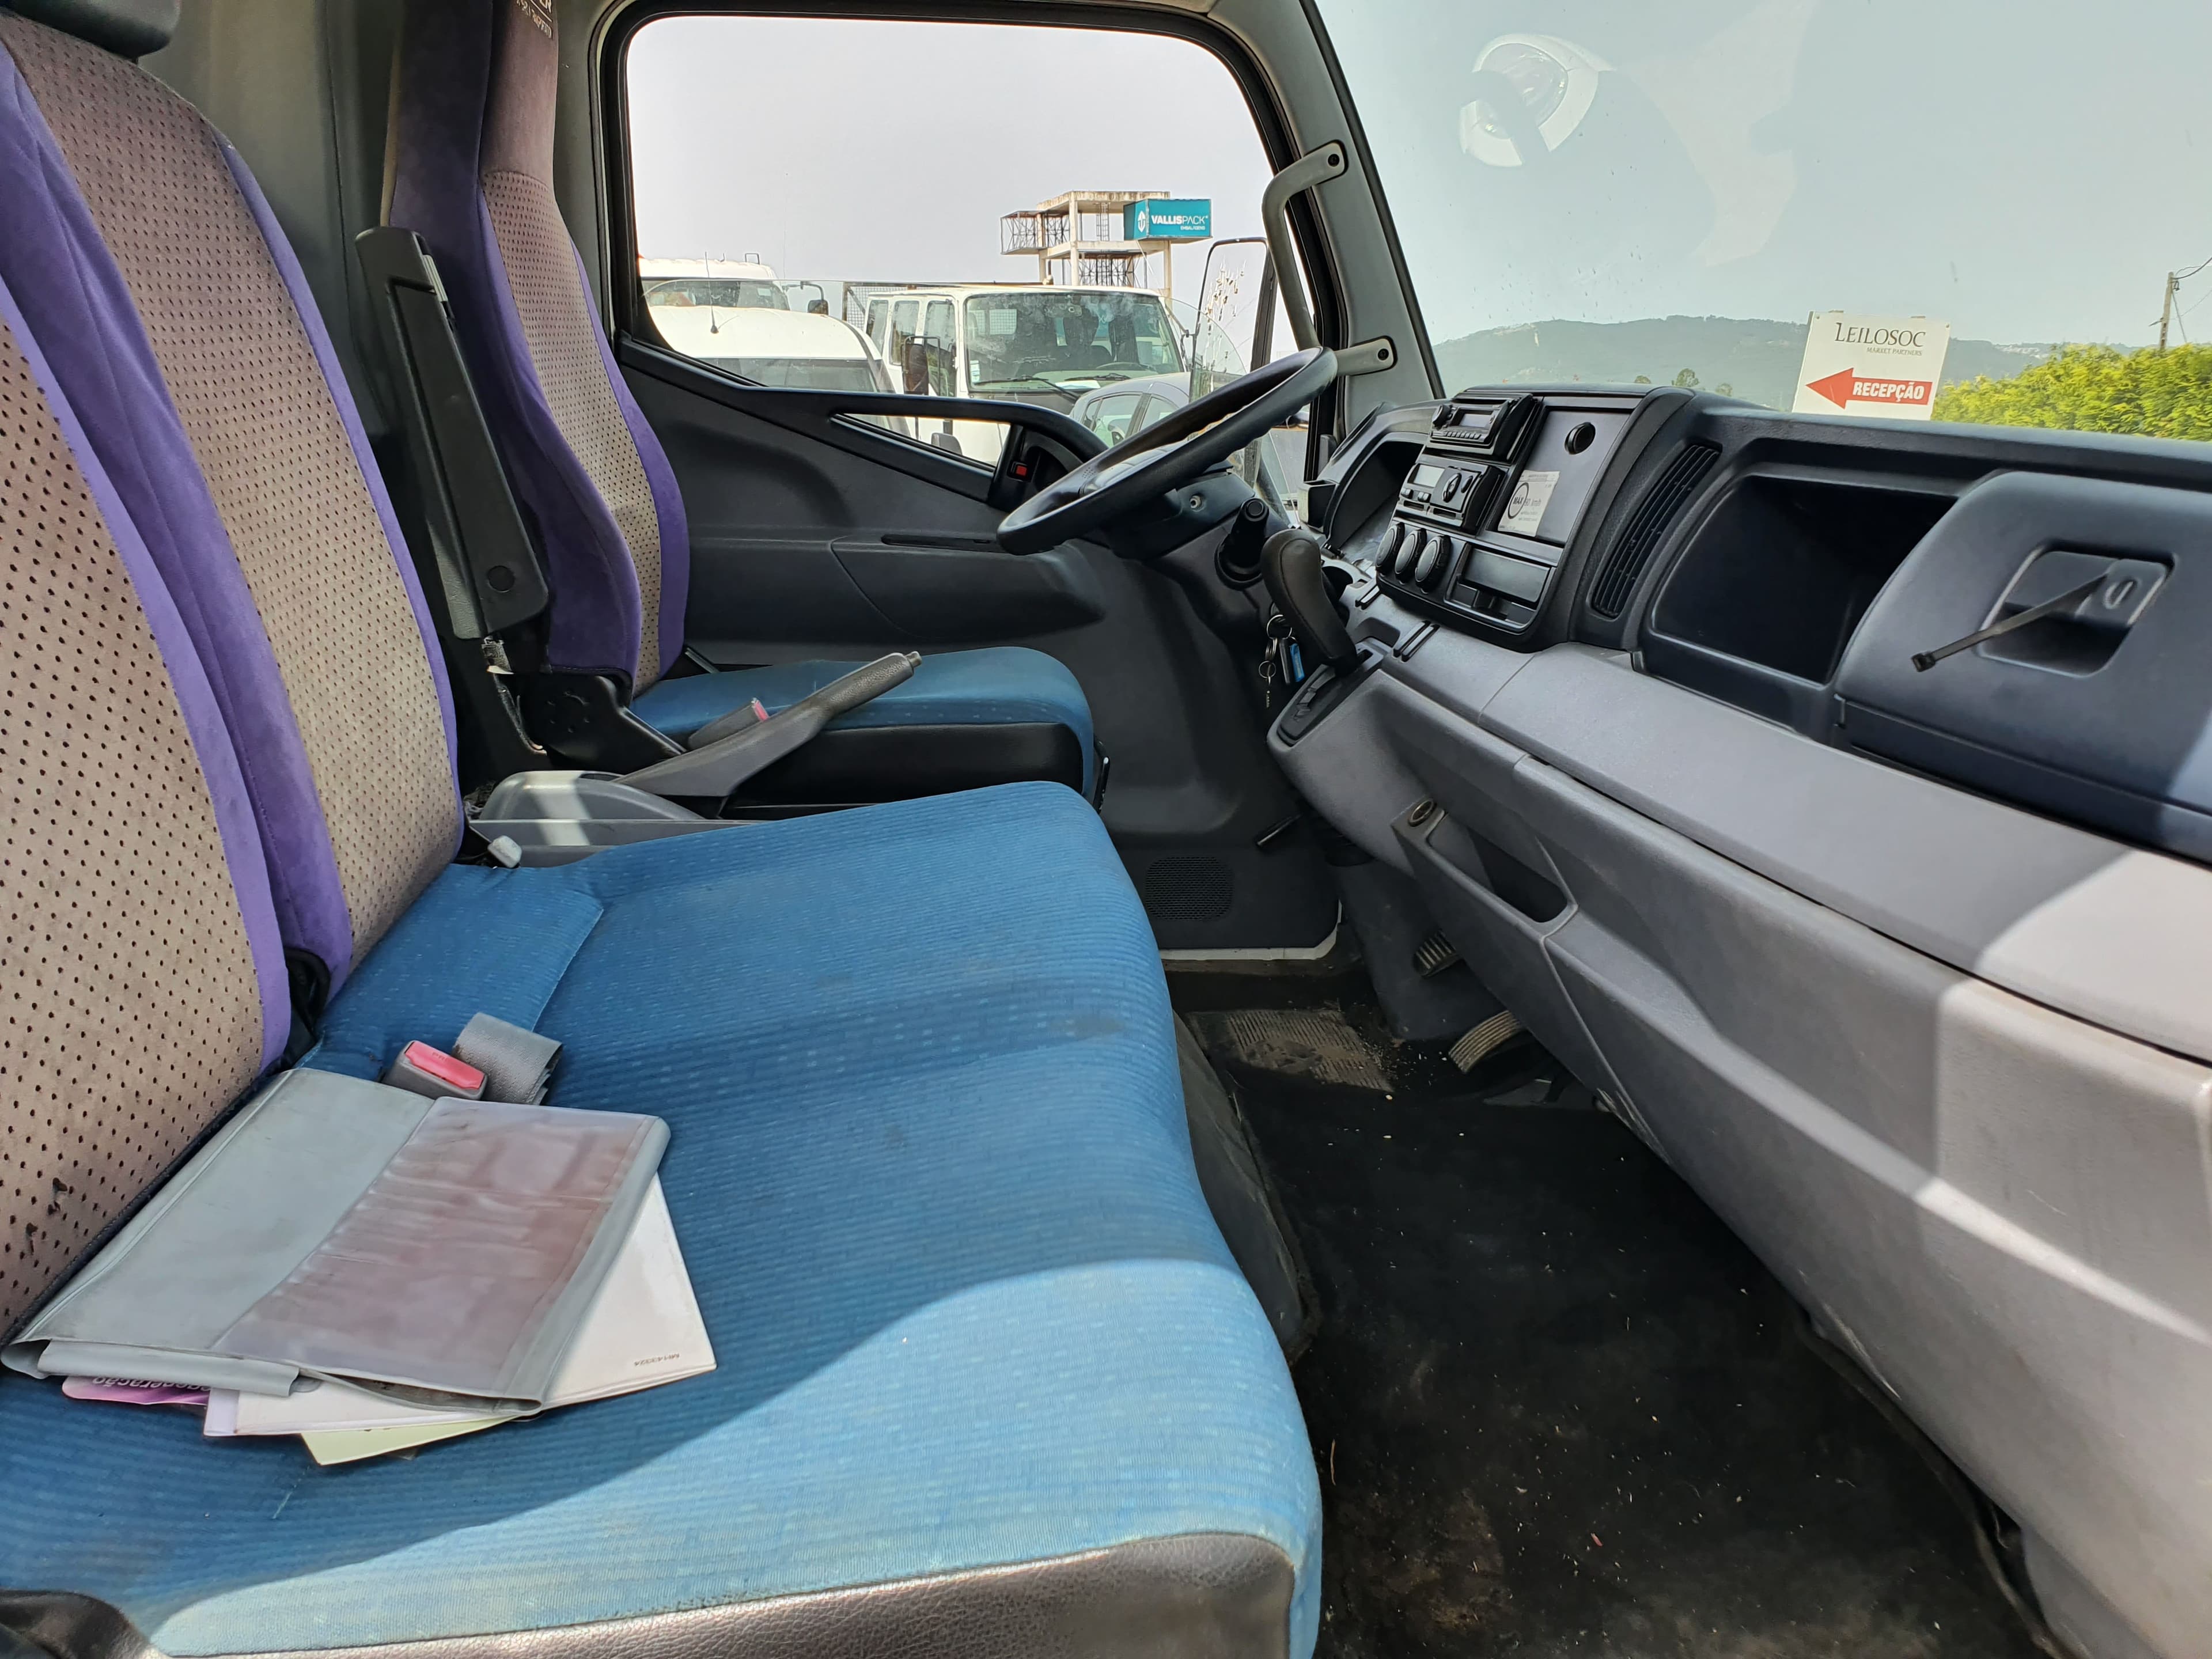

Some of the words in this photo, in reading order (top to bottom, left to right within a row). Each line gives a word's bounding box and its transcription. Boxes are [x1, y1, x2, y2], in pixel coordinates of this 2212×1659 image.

[1151, 215, 1205, 224] VALLISPACK
[1835, 322, 1926, 347] LEILOSOC
[1853, 381, 1925, 402] RECEPÇÃO
